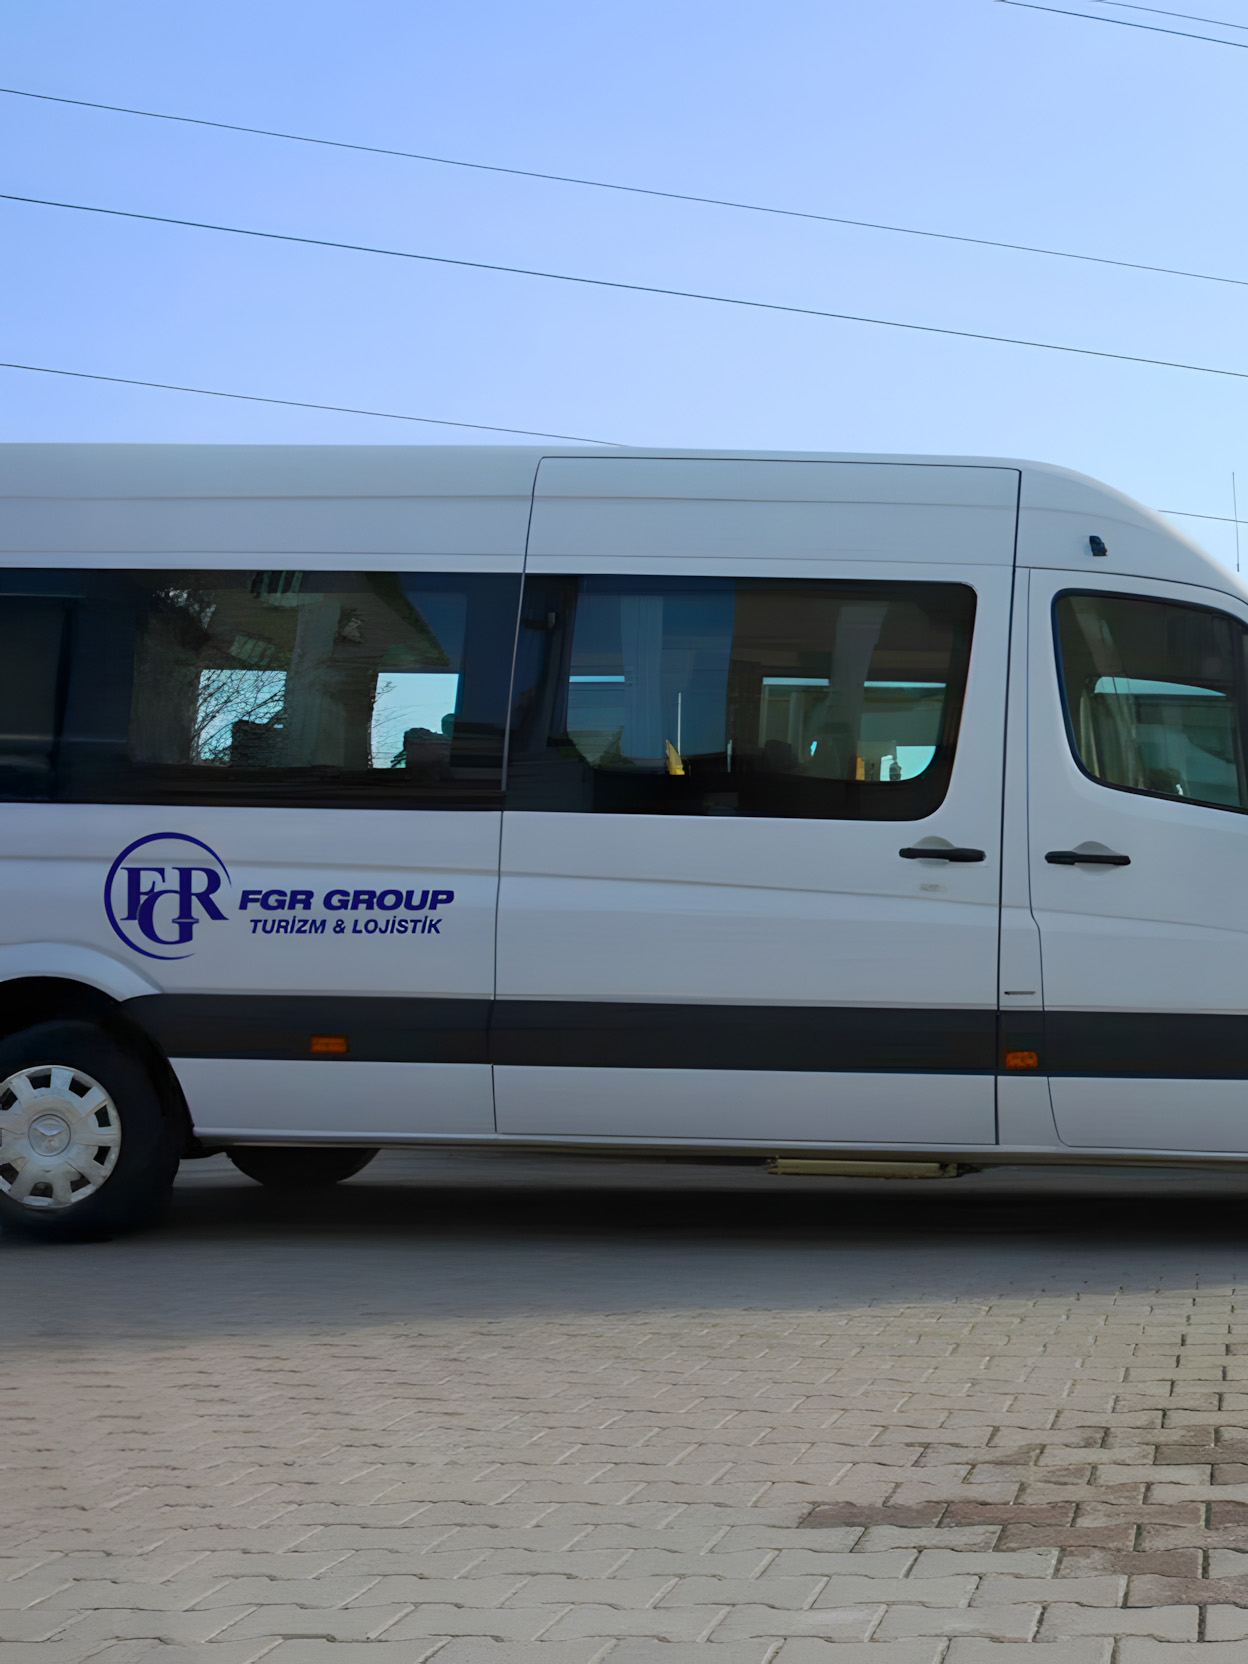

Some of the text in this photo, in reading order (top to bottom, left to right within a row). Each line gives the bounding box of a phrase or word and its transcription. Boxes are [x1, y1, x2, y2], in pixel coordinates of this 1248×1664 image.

[239, 889, 454, 911] FGR GROUP
[250, 915, 443, 934] TURİZM & LOJİSTİK
